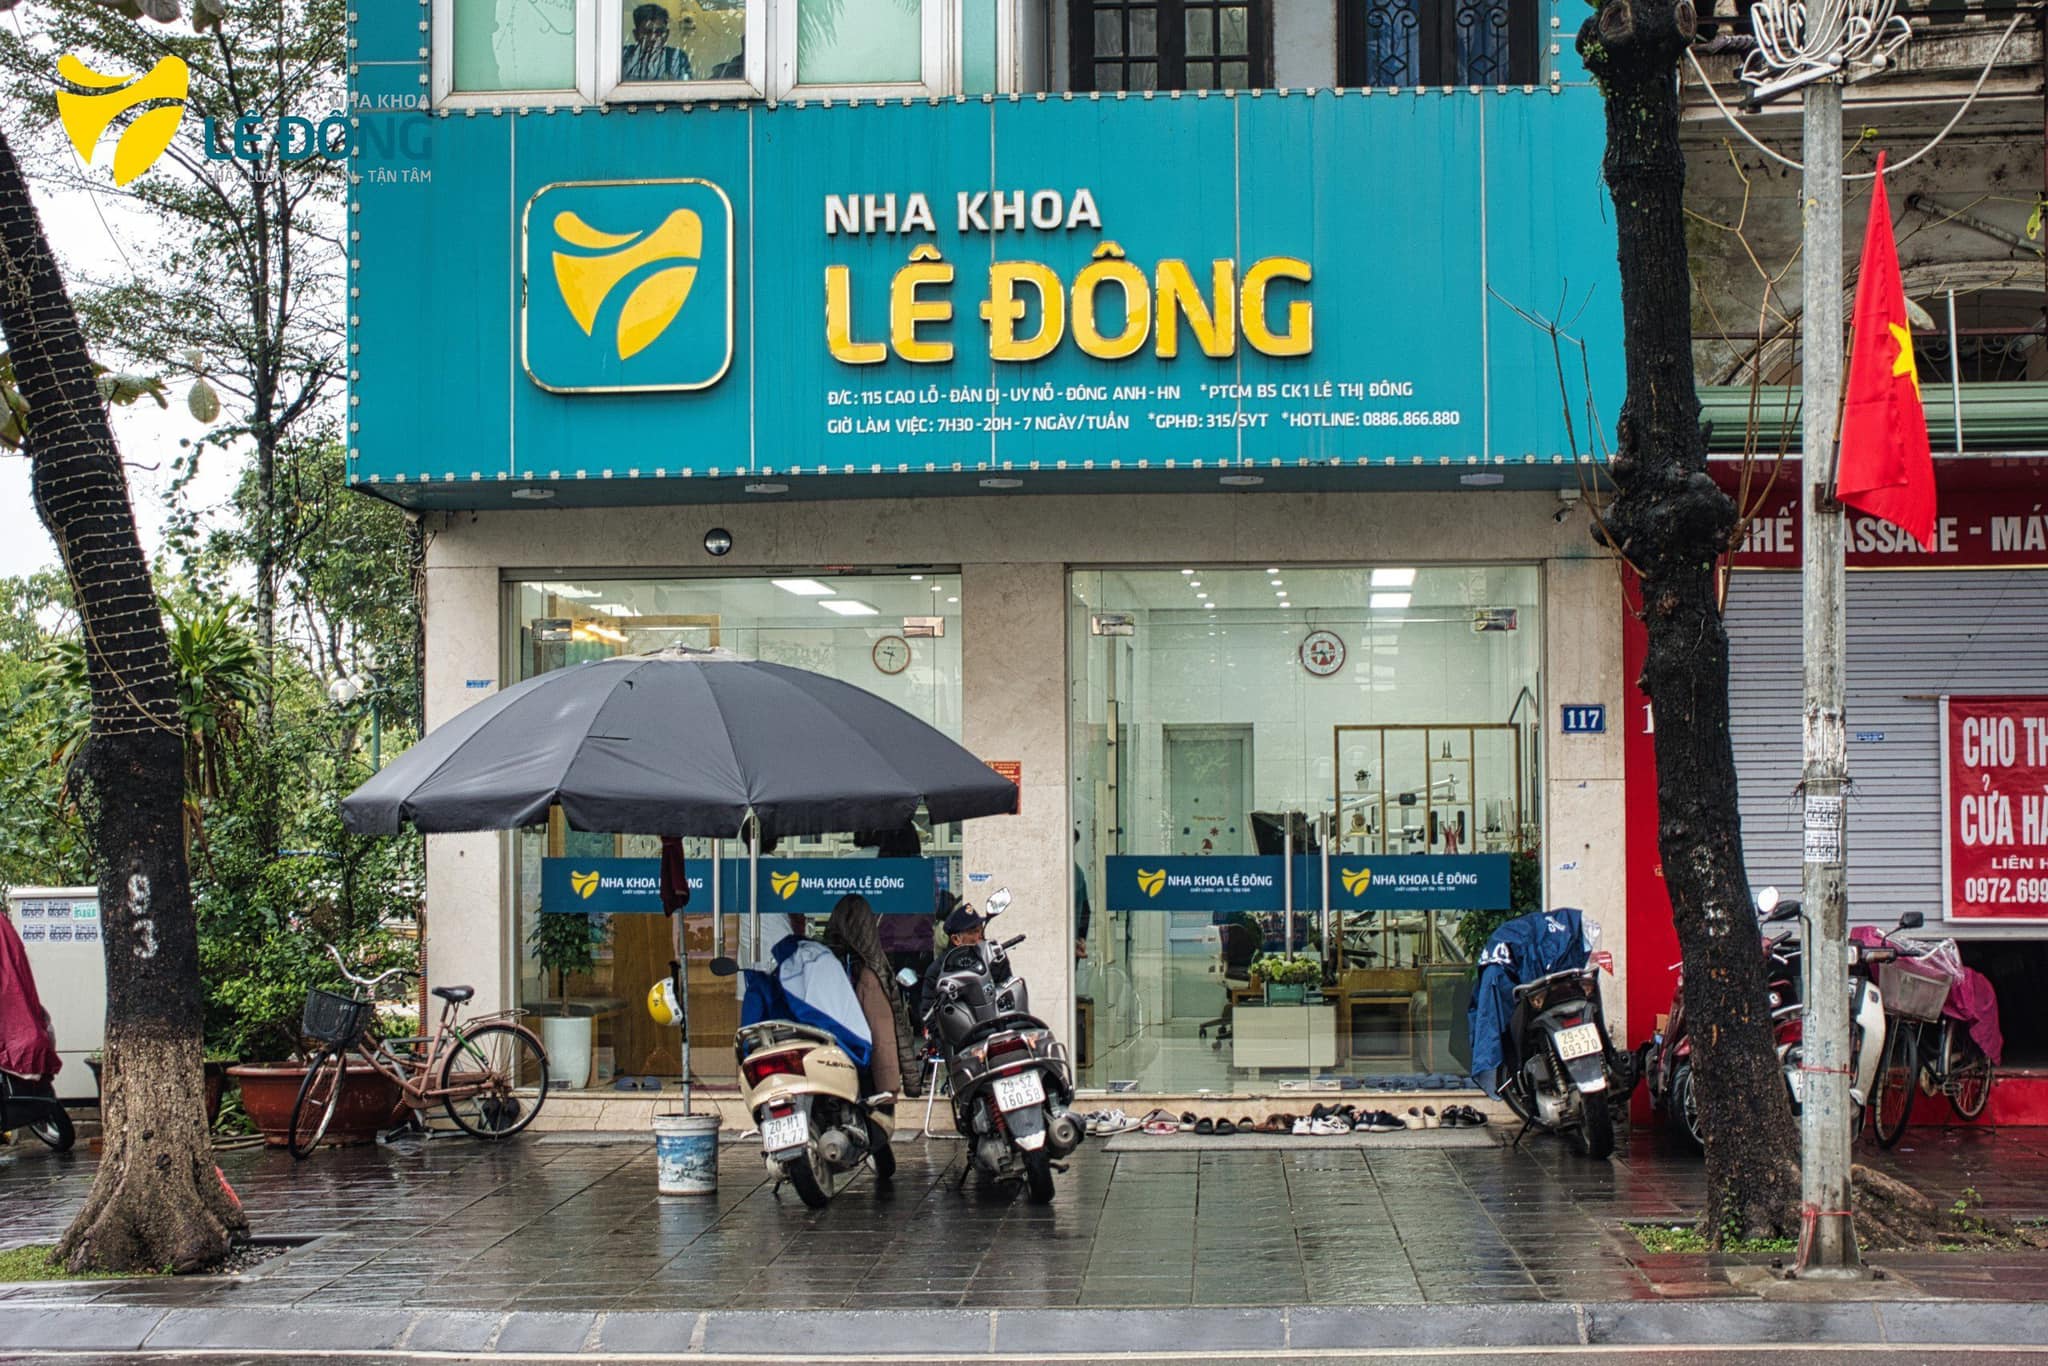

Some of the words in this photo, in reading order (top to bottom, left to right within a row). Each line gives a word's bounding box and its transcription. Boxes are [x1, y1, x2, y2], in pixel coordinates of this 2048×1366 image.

[825, 193, 937, 234] NHA
[957, 188, 1102, 232] KHOA
[825, 243, 955, 365] LÊ
[979, 240, 1314, 361] ĐÔNG
[861, 390, 882, 404] 115
[885, 389, 915, 404] CAO
[919, 384, 939, 404] LỖ
[986, 386, 1000, 405] DỊ
[1065, 384, 1107, 401] ĐÔNG
[1112, 386, 1146, 400] ANH
[1158, 386, 1181, 400] HN
[1257, 383, 1277, 398] BS
[1281, 383, 1309, 398] CK1
[1314, 380, 1332, 398] LÊ
[1338, 382, 1363, 400] THỊ
[1369, 380, 1413, 397] ĐÔNG
[827, 415, 853, 433] GIỜ
[856, 415, 890, 433] LÀM
[896, 416, 933, 436] VIỆC:
[1023, 417, 1032, 430] 7
[1206, 411, 1269, 428] 315/SYT
[1363, 410, 1460, 426] 0886.866.880
[1991, 504, 2048, 551] MÁ
[1567, 710, 1600, 728] 117
[1962, 716, 2016, 767] CHO
[1960, 773, 2014, 846] CỬA
[1991, 854, 2034, 870] LIÊN
[601, 878, 624, 889] NHA
[626, 878, 656, 889] KHOA
[801, 878, 824, 889] NHA
[827, 878, 857, 889] KHOA
[859, 875, 871, 889] LÊ
[874, 875, 905, 889] ĐÔNG
[1168, 875, 1191, 886] NHA
[1194, 875, 1224, 886] KHOA
[1227, 872, 1239, 886] LÊ
[1241, 873, 1272, 886] ĐÔNG
[1372, 874, 1396, 885] NHA
[1399, 874, 1429, 885] KHOA
[1432, 871, 1444, 885] LÊ
[1446, 872, 1477, 885] ĐÔNG
[1965, 877, 2048, 903] 0972.699
